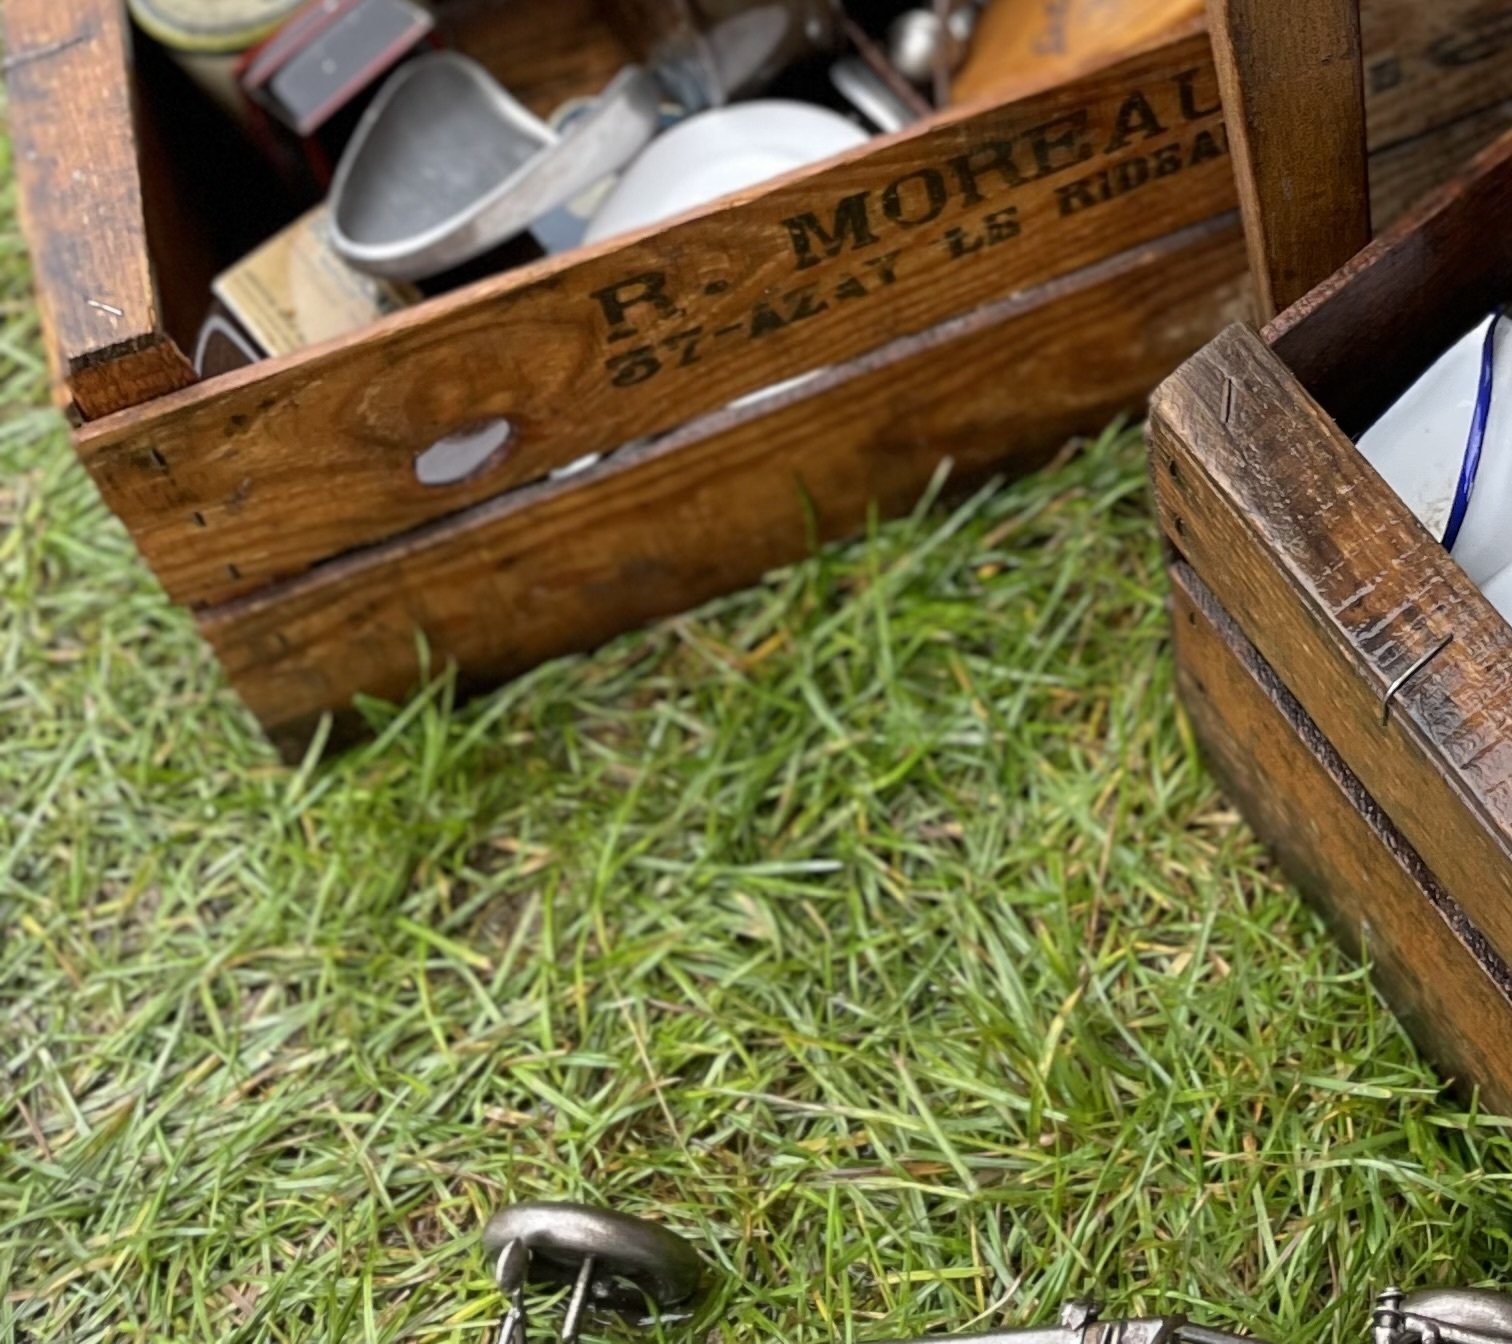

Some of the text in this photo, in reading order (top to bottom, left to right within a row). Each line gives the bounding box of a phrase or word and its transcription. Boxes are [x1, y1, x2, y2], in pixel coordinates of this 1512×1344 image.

[780, 67, 1222, 272] MOREAU
[944, 206, 1021, 259] LE
[1054, 121, 1229, 219] RIDEA
